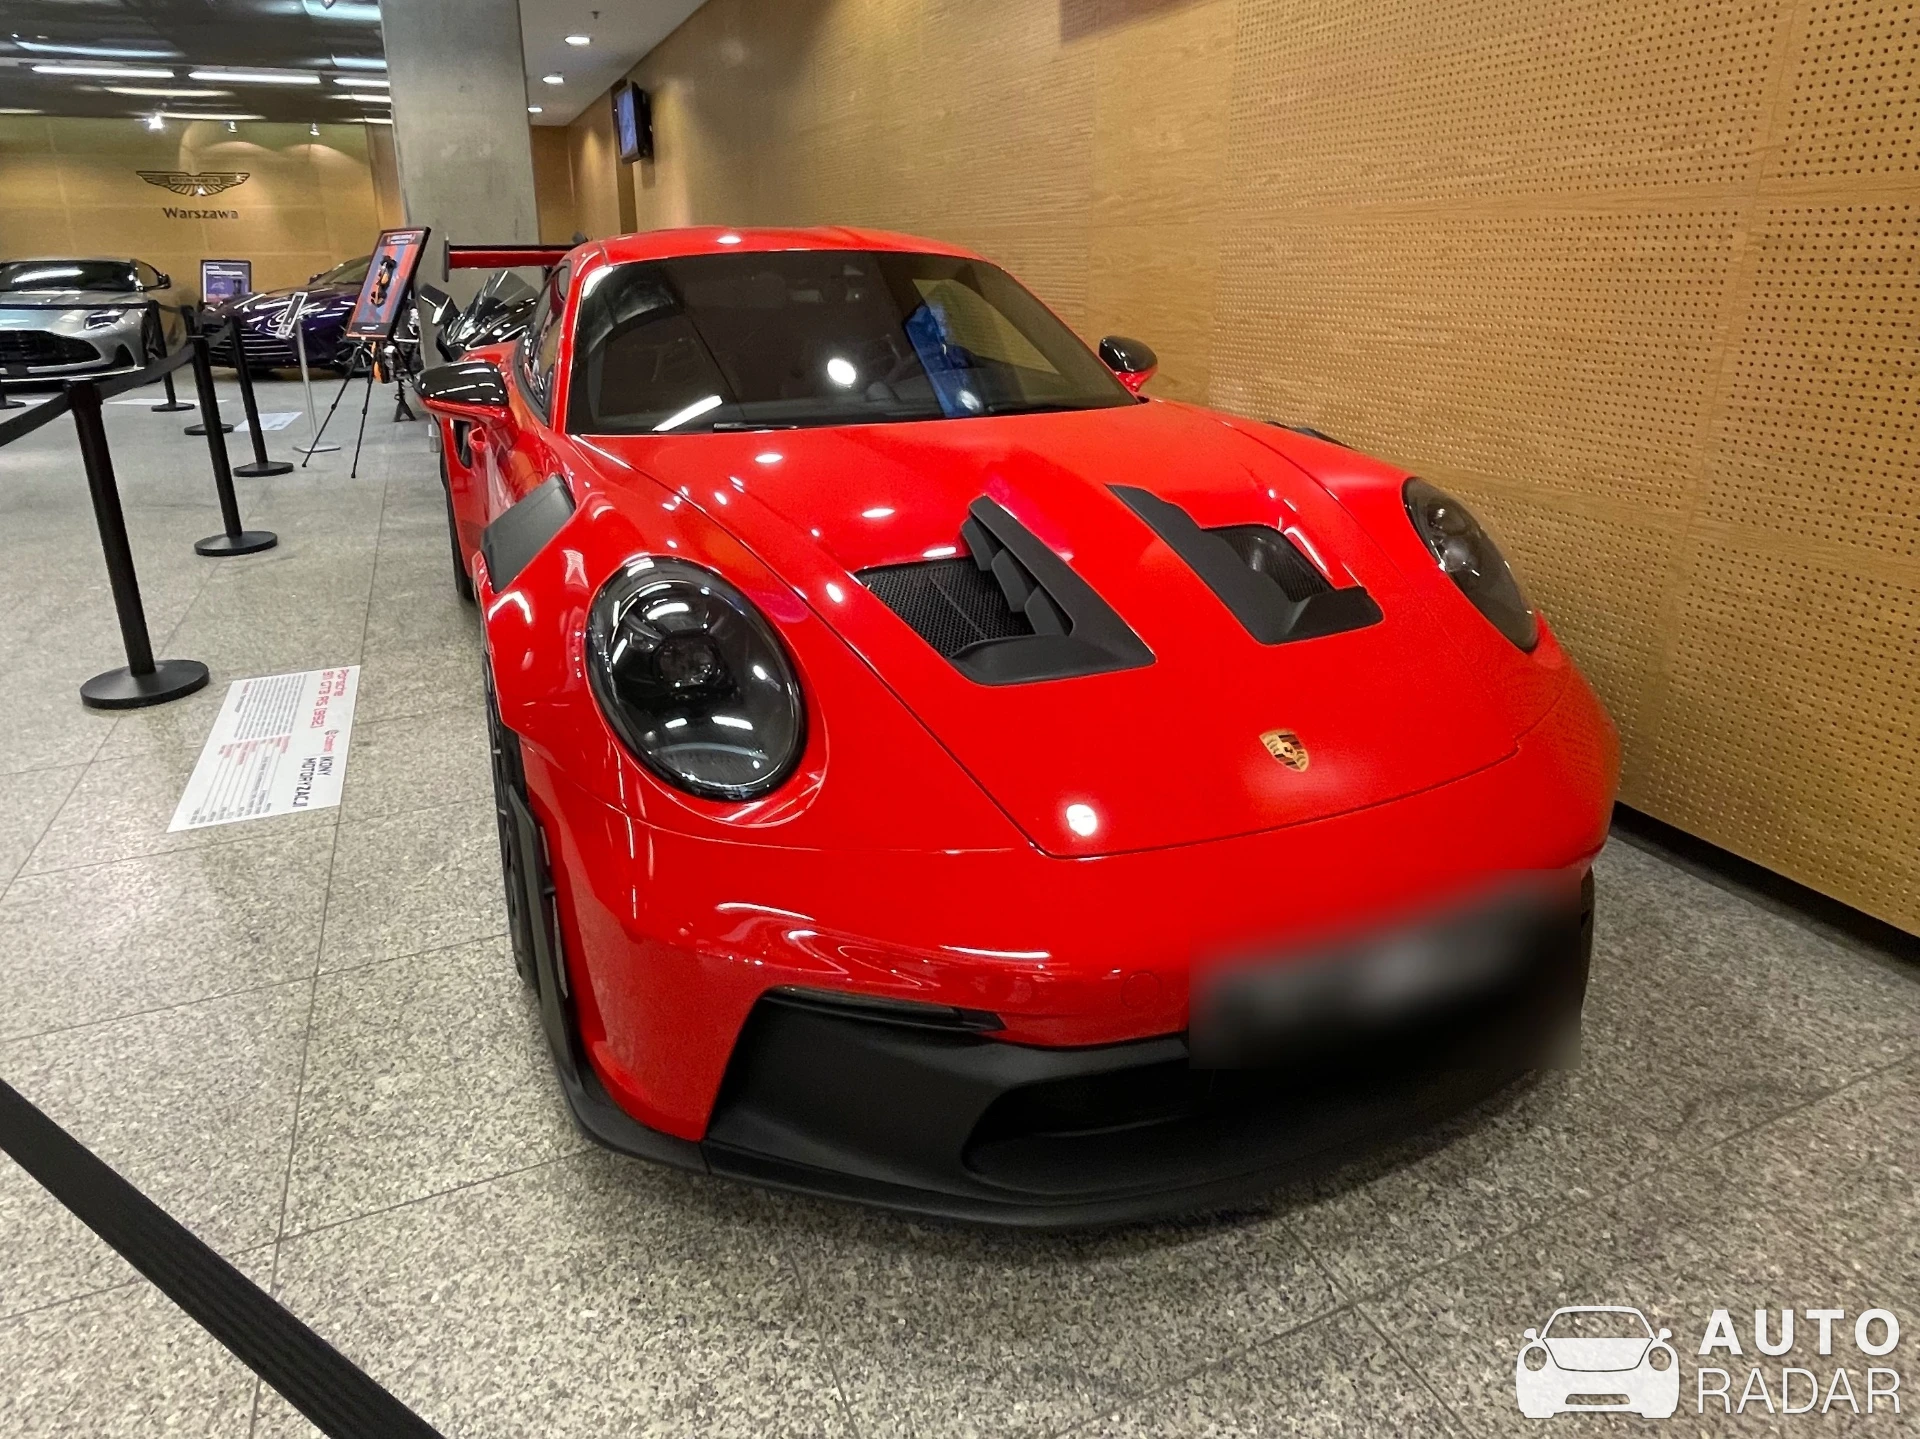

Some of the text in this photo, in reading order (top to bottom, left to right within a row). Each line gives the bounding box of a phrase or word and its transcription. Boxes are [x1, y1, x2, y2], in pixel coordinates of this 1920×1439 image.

[162, 207, 239, 220] Warszawa
[318, 681, 332, 695] GT3
[333, 669, 349, 697] Porsche
[315, 696, 329, 707] RS
[310, 707, 328, 729] (992)
[317, 756, 334, 776] IKONY
[292, 757, 317, 808] MOTORYZACJI
